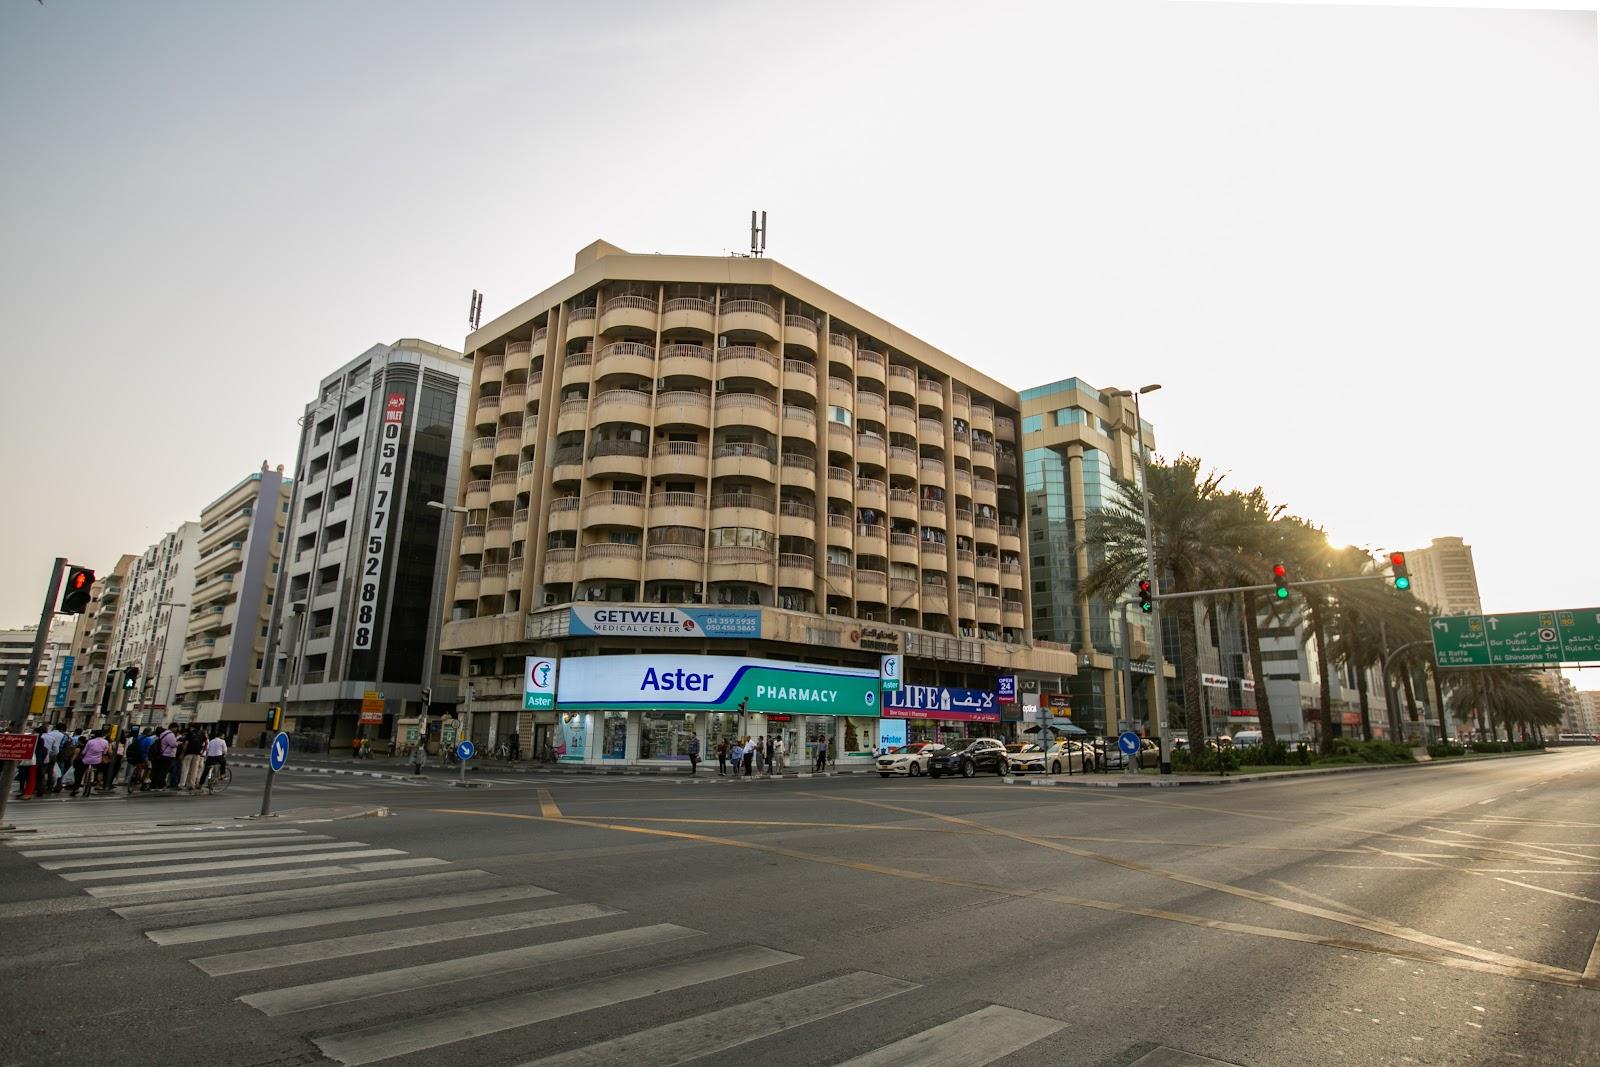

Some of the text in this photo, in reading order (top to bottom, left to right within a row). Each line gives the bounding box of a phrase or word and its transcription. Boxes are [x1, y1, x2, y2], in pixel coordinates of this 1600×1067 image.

[593, 610, 680, 624] GETWELL
[593, 624, 680, 633] MEDICAL CENTER
[1504, 653, 1543, 661] Shindagha
[640, 667, 714, 692] Aster
[882, 681, 898, 690] Aster
[756, 685, 838, 702] PHARMACY
[889, 684, 940, 710] LIFE
[527, 696, 552, 706] Aster
[952, 691, 995, 712] لايف
